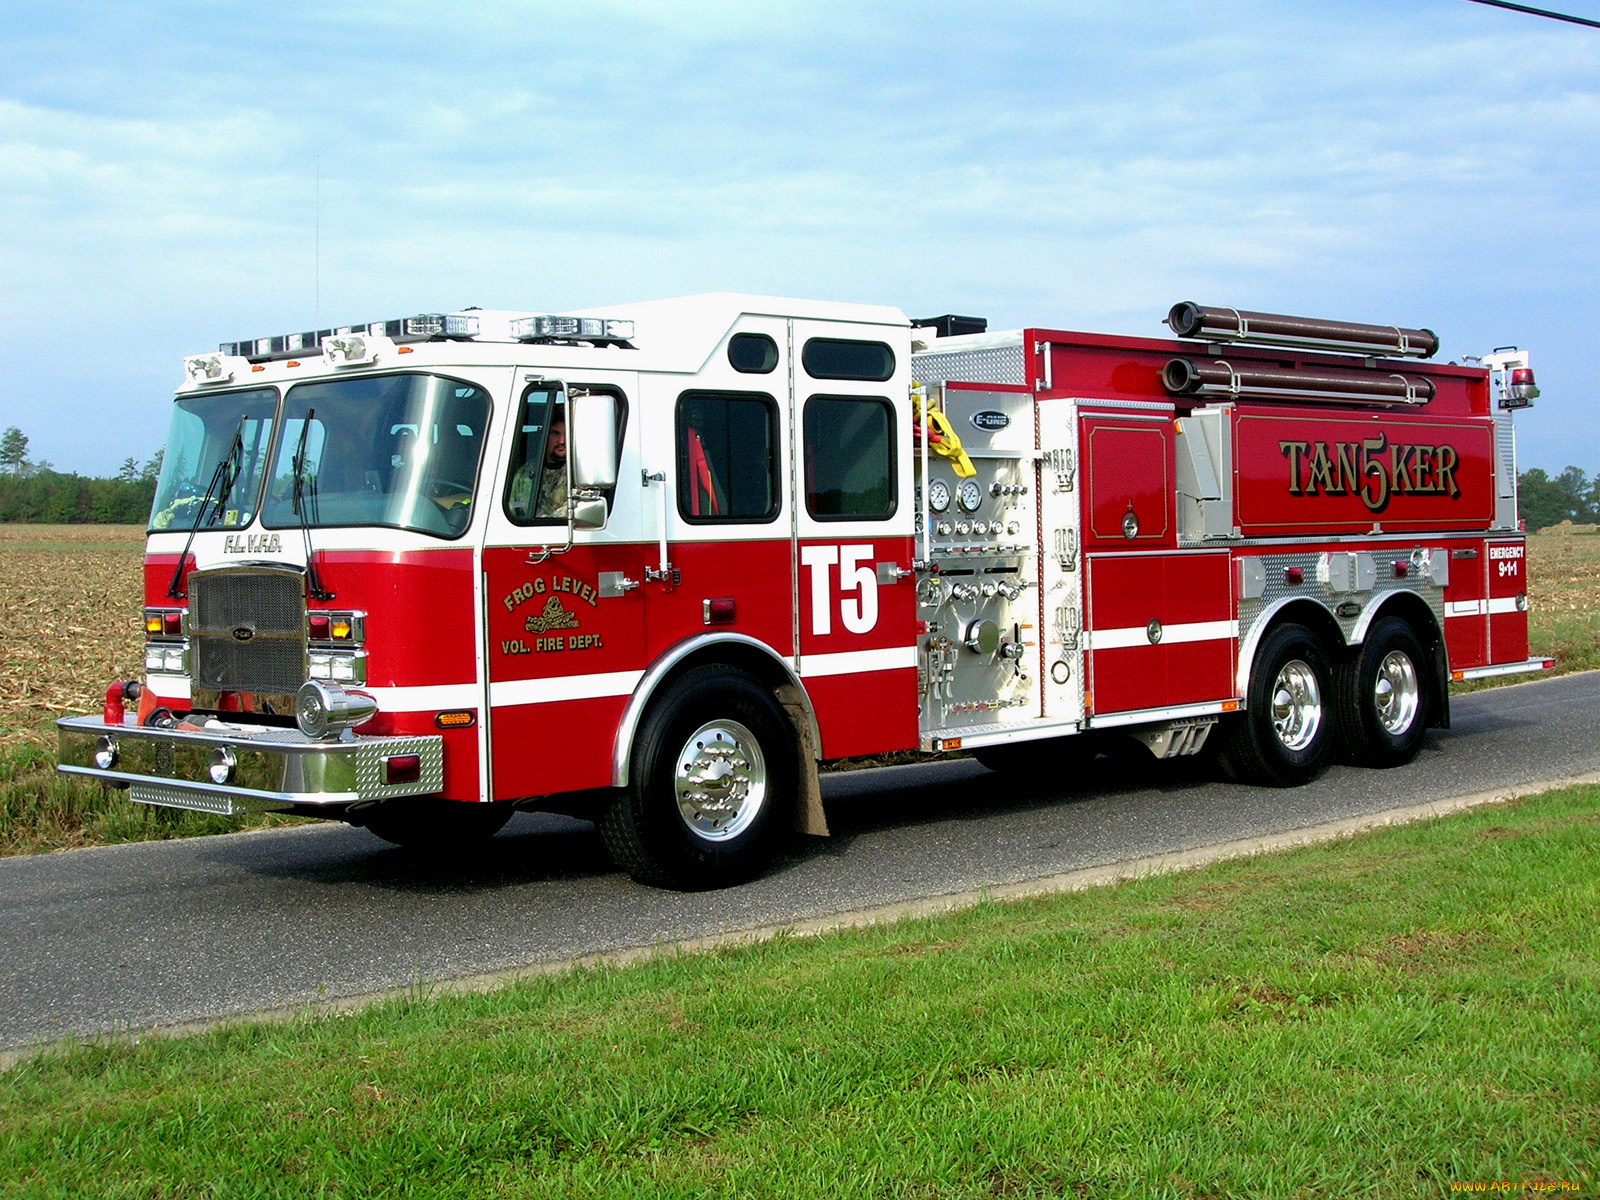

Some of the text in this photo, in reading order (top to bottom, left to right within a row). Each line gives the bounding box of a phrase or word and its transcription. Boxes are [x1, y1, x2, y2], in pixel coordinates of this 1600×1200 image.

[976, 415, 1007, 425] E-ONE
[1490, 546, 1524, 559] EMERGENCY
[504, 575, 598, 612] FROG LEVEL
[801, 544, 879, 635] T5
[501, 633, 602, 655] VOL. FIRE DEPT.
